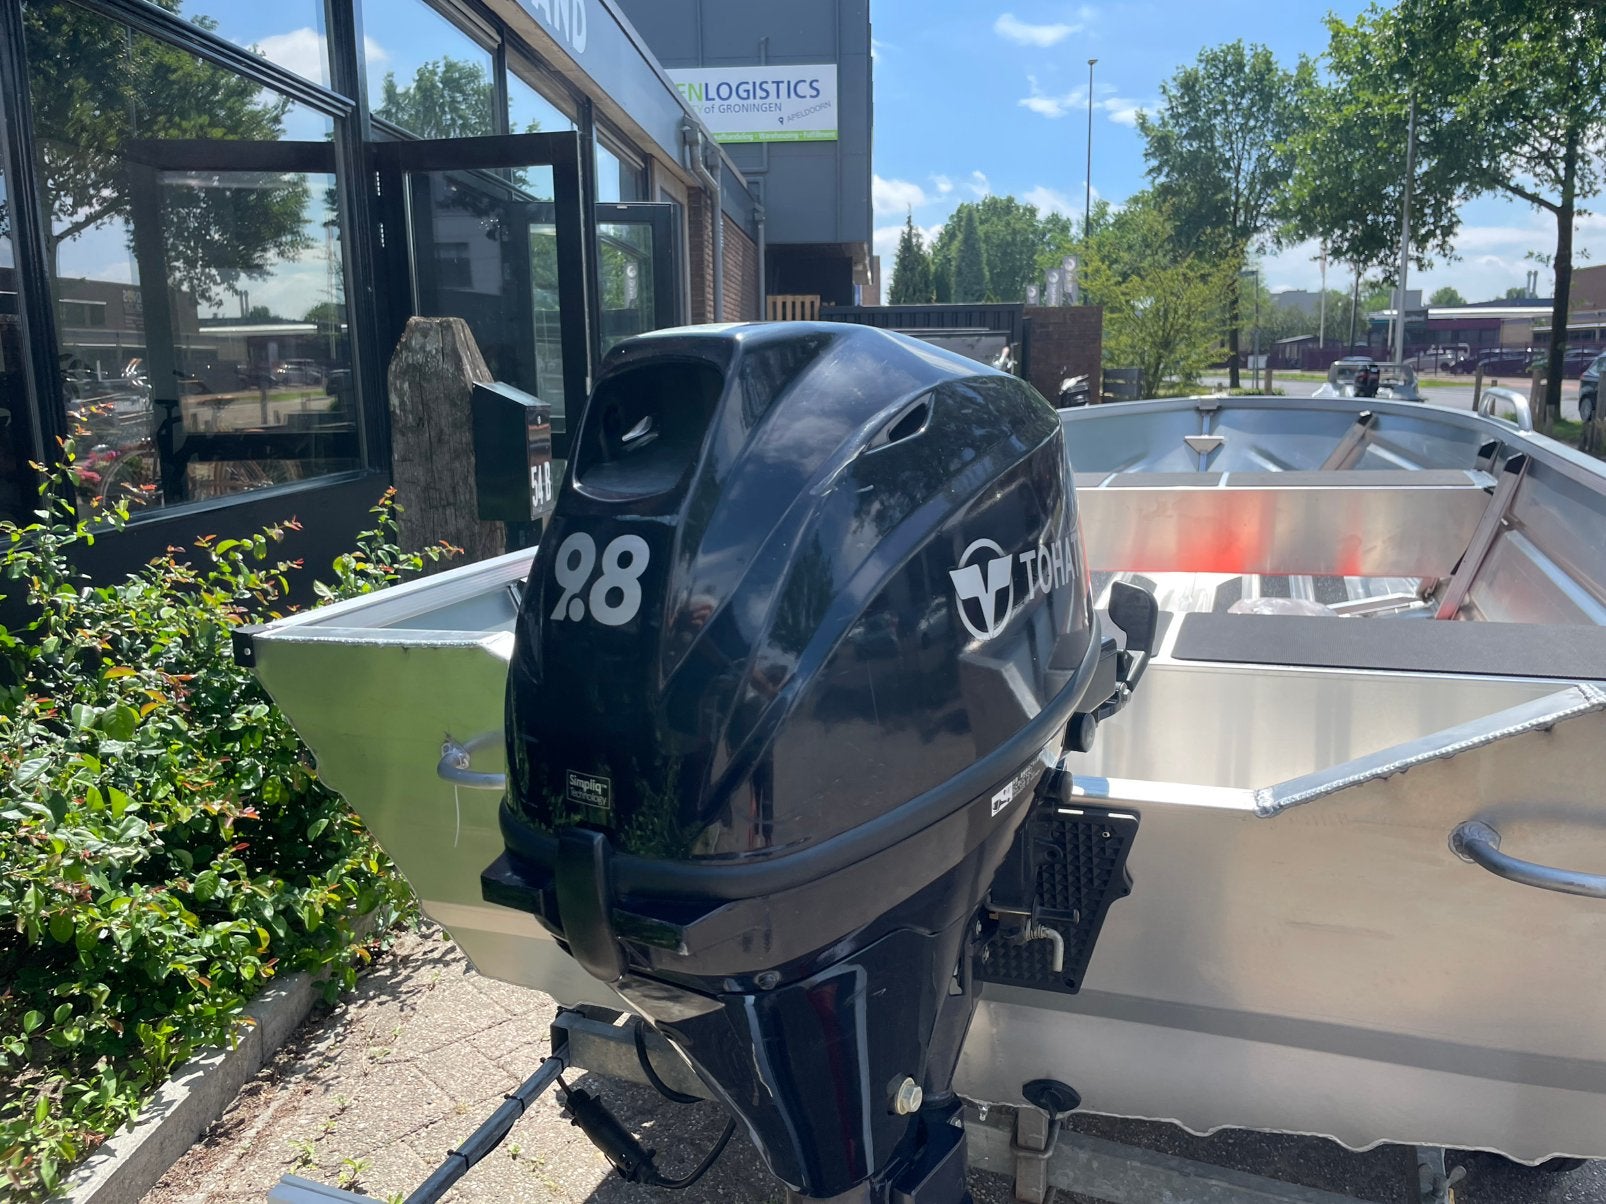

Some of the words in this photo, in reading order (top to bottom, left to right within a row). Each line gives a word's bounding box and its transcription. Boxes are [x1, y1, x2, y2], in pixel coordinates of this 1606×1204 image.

[718, 102, 782, 114] GRONINGEN
[786, 100, 832, 122] APELDOORN
[550, 531, 650, 627] 9.8
[570, 786, 607, 806] Technology
